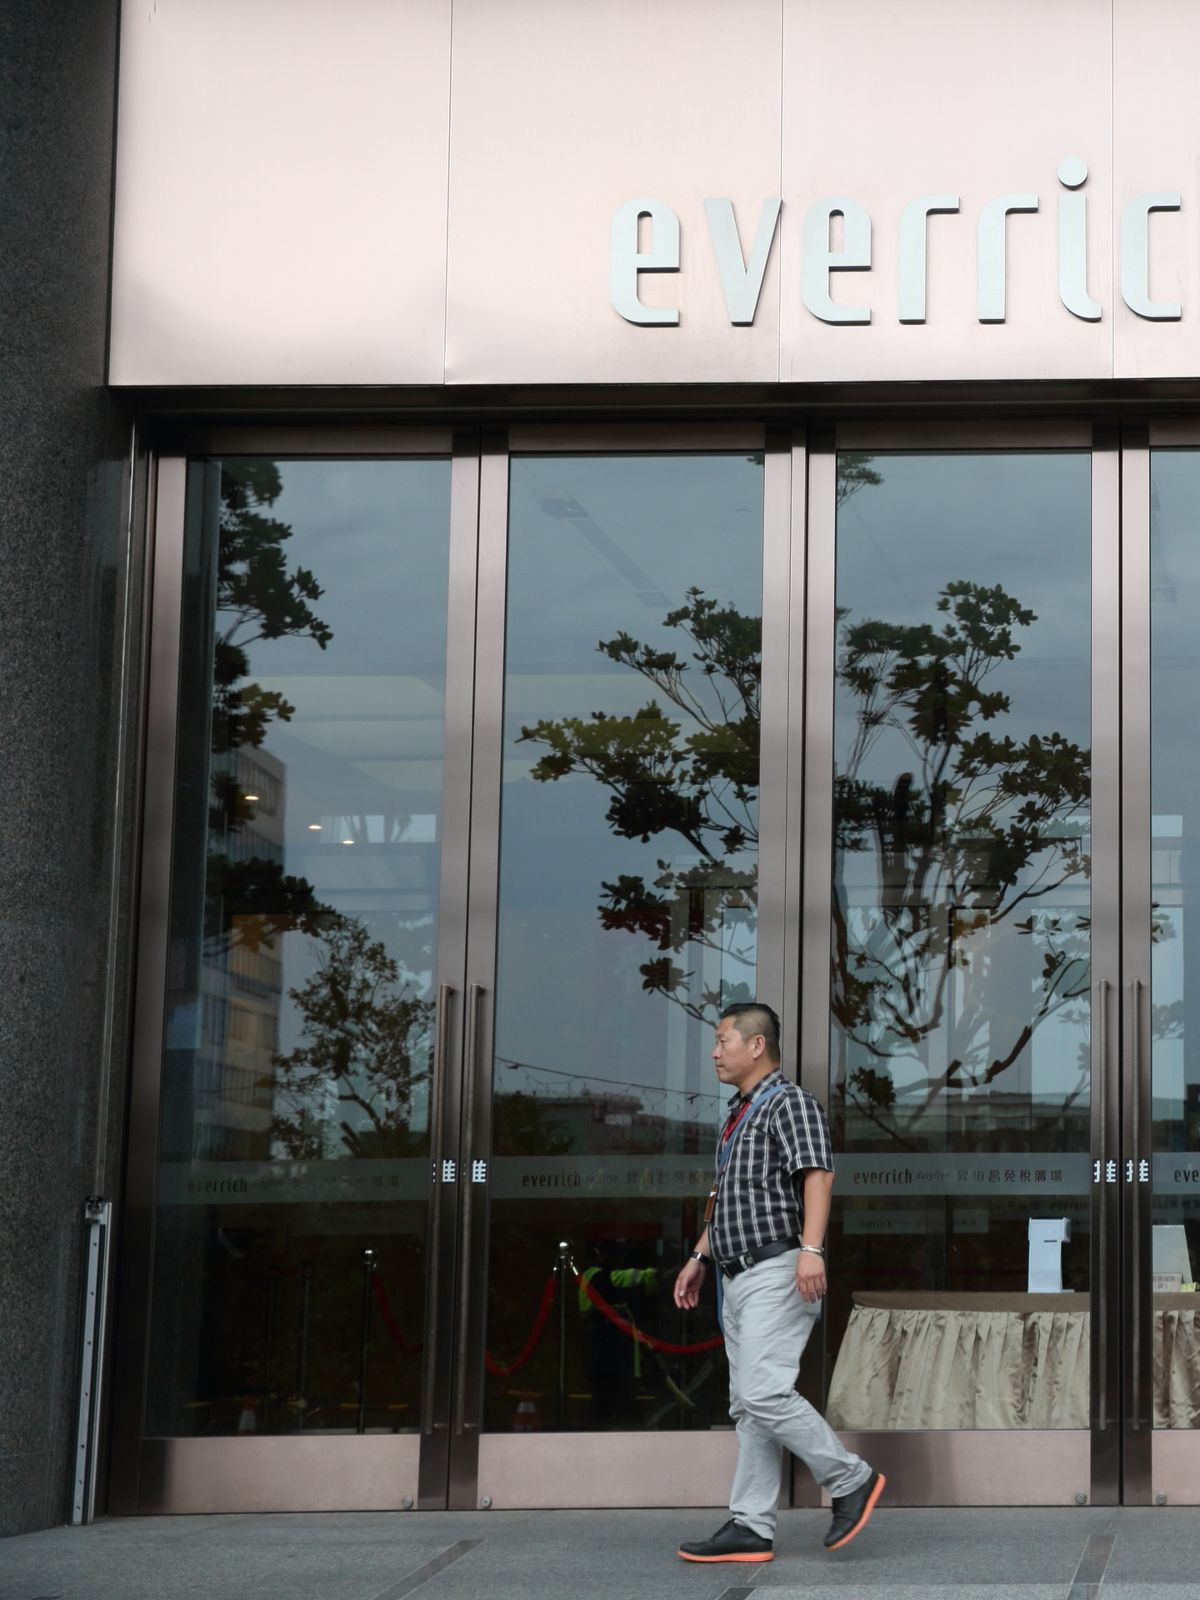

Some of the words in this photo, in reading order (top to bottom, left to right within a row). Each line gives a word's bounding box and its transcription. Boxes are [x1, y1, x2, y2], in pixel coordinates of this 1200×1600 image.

[522, 1169, 581, 1187] everrich
[853, 1168, 913, 1185] everrich
[1093, 1160, 1116, 1183] 推
[1126, 1159, 1149, 1182] 推
[187, 1175, 248, 1193] everrich
